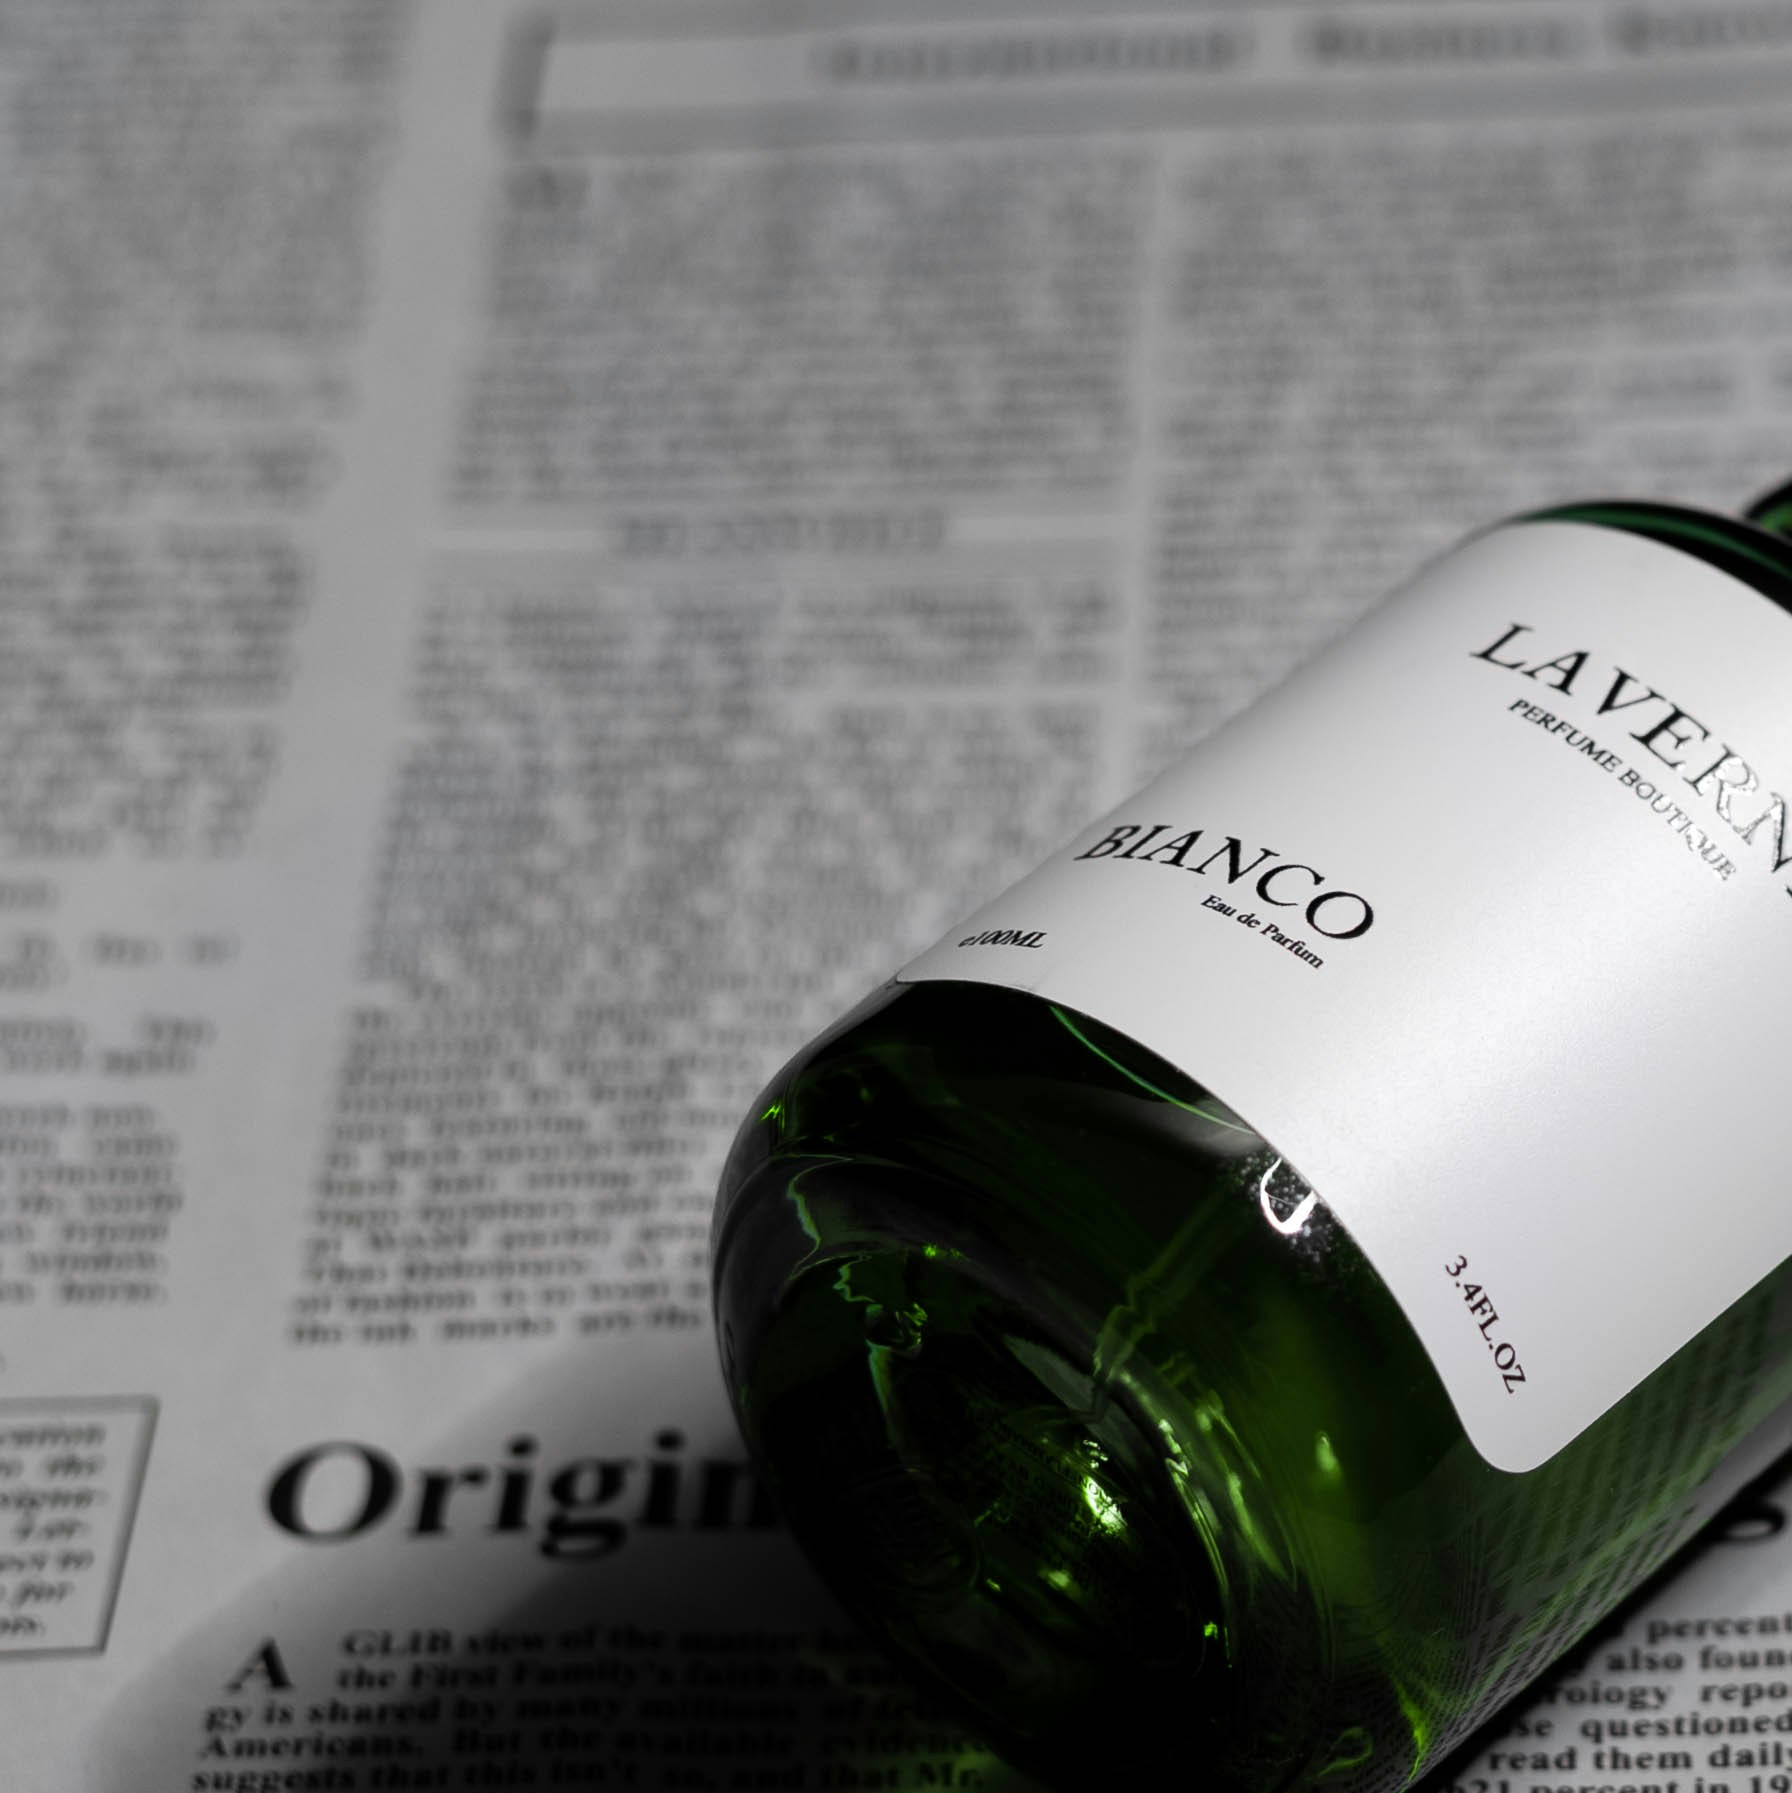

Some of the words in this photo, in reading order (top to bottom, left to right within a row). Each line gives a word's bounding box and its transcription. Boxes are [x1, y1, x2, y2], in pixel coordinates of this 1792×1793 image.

[1508, 698, 1624, 775] PERFUME
[1617, 767, 1738, 881] BOUTIQUE
[1073, 824, 1374, 940] BIANCO
[1200, 894, 1237, 918] Eau
[1236, 912, 1261, 930] de
[1259, 922, 1326, 971] Parfum
[1444, 1254, 1527, 1394] 3.4FL.OZ
